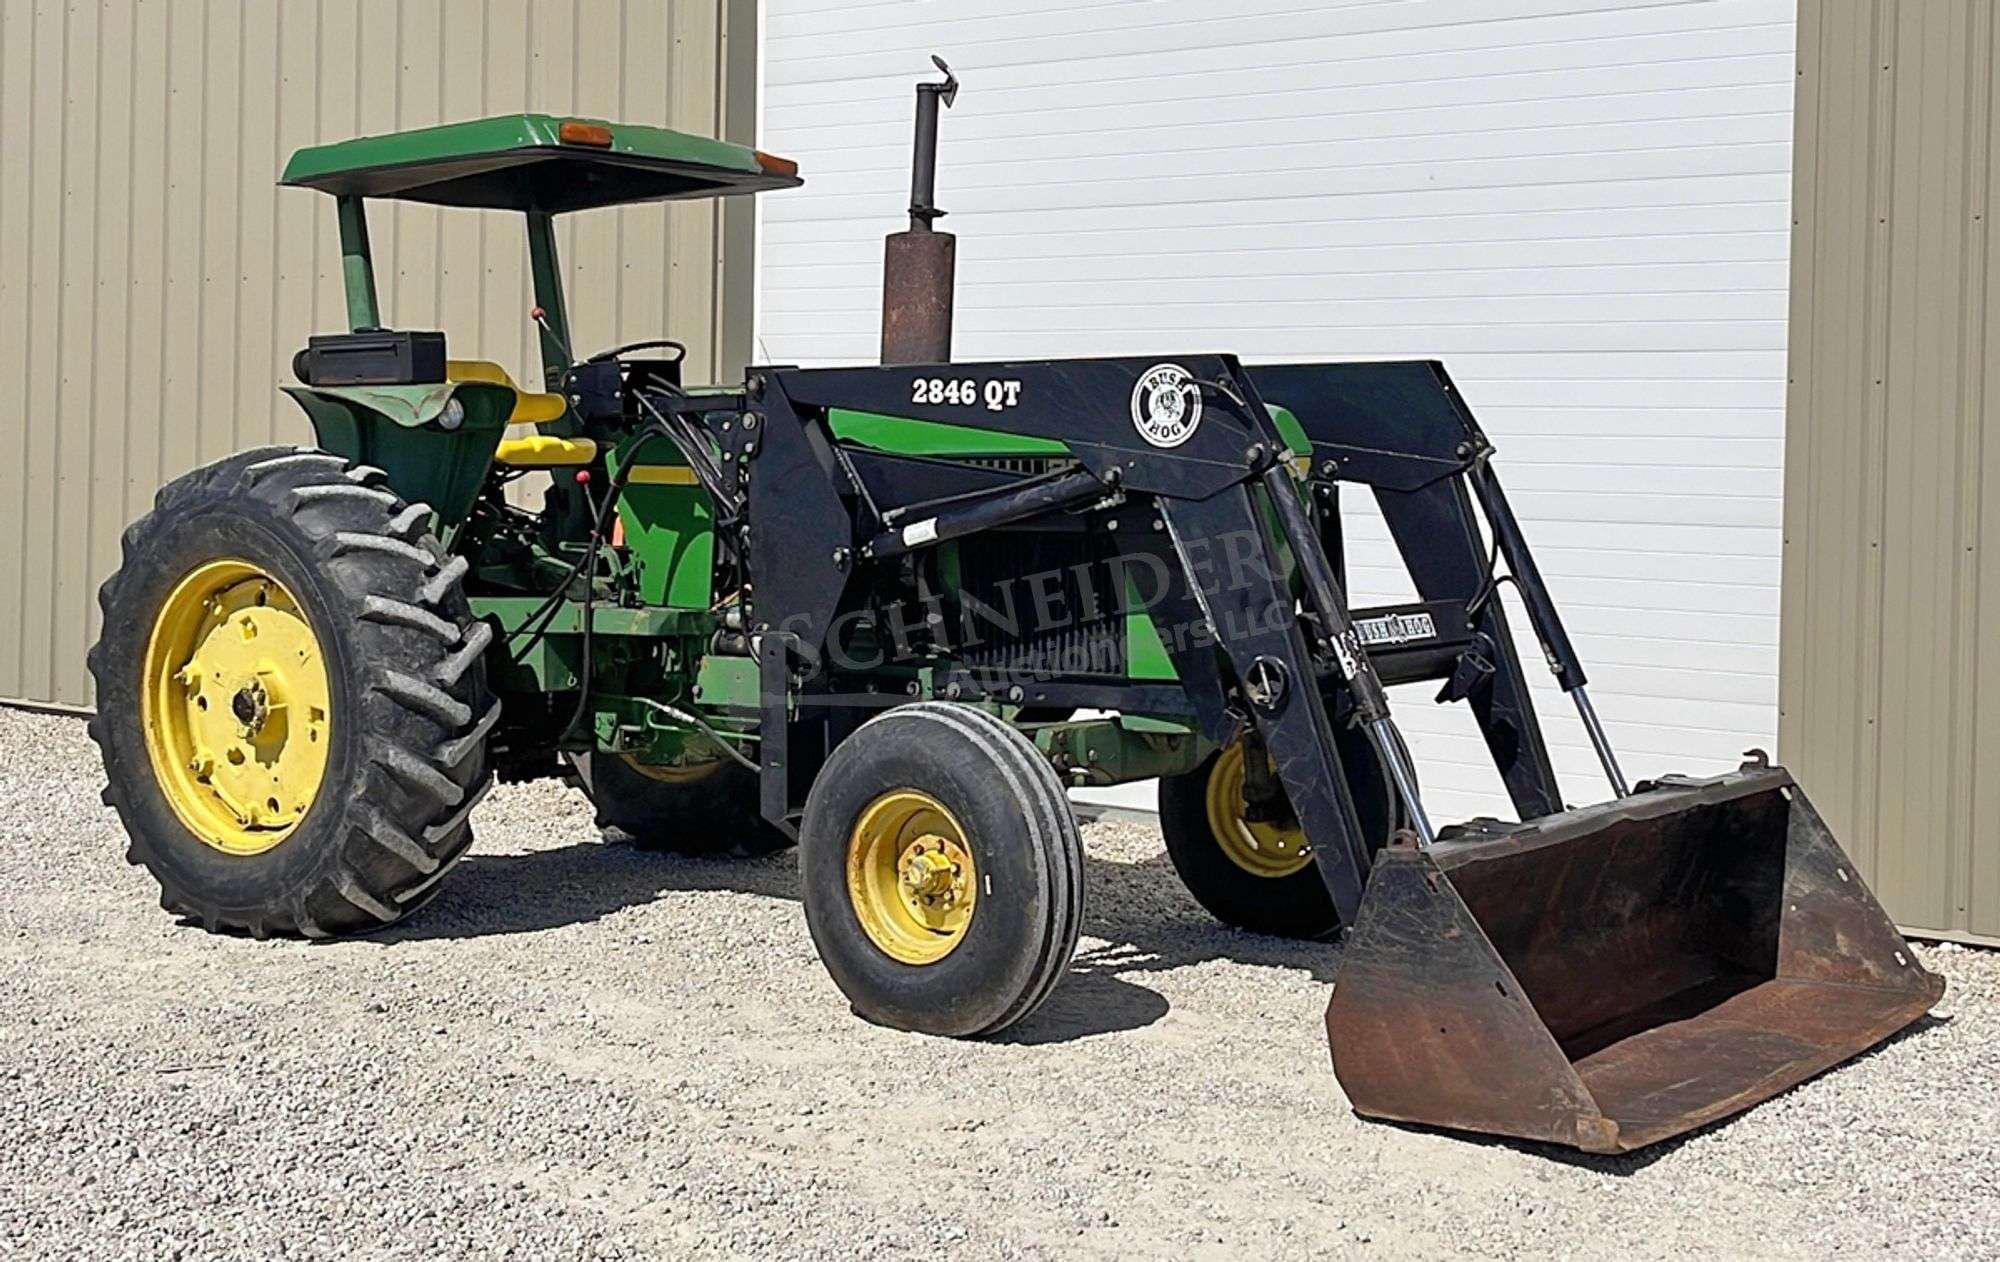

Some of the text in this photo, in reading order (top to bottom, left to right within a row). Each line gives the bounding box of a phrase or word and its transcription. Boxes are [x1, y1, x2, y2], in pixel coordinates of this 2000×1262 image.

[912, 378, 1021, 411] 2846 QT
[1148, 422, 1181, 438] HOG
